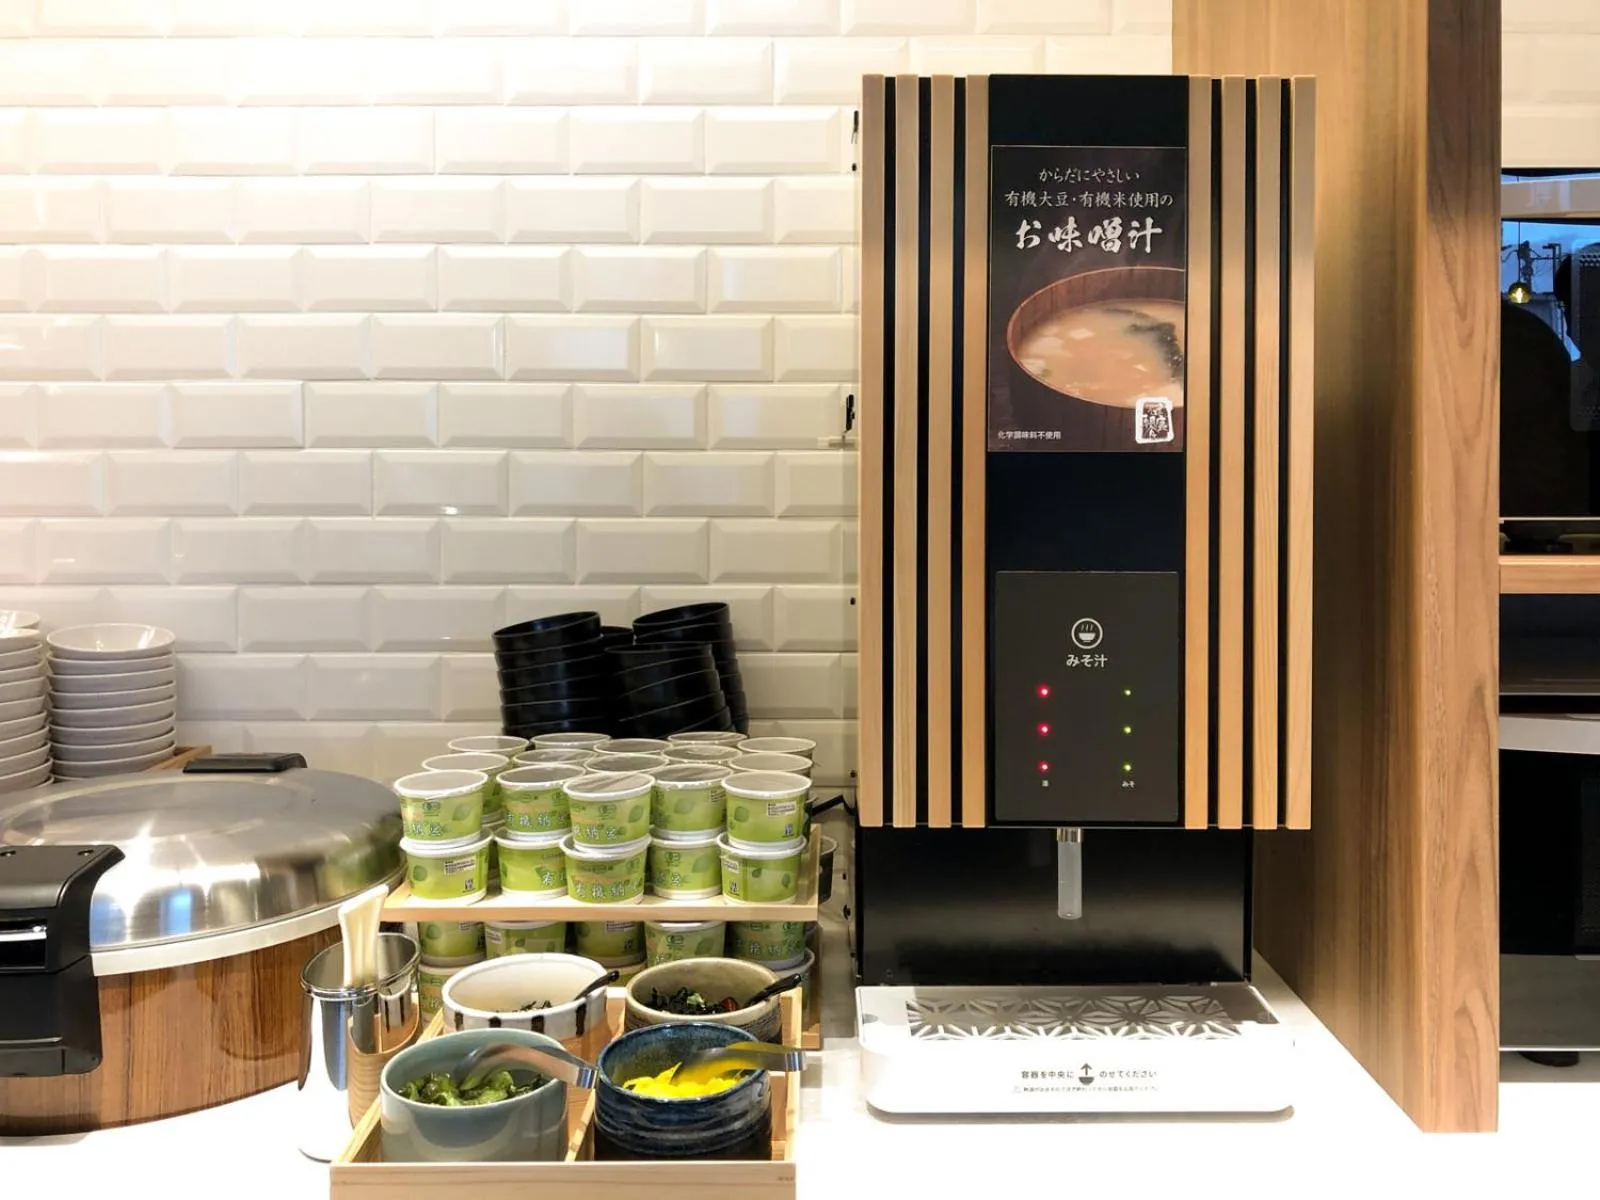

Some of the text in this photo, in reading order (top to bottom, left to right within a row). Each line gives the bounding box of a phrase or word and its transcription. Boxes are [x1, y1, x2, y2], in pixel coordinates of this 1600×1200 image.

[1039, 168, 1140, 183] からだにやさしい
[1004, 190, 1174, 208] 有機大豆・有機米使用の
[1015, 216, 1163, 253] お味噌汁
[1066, 654, 1108, 668] みそ汁
